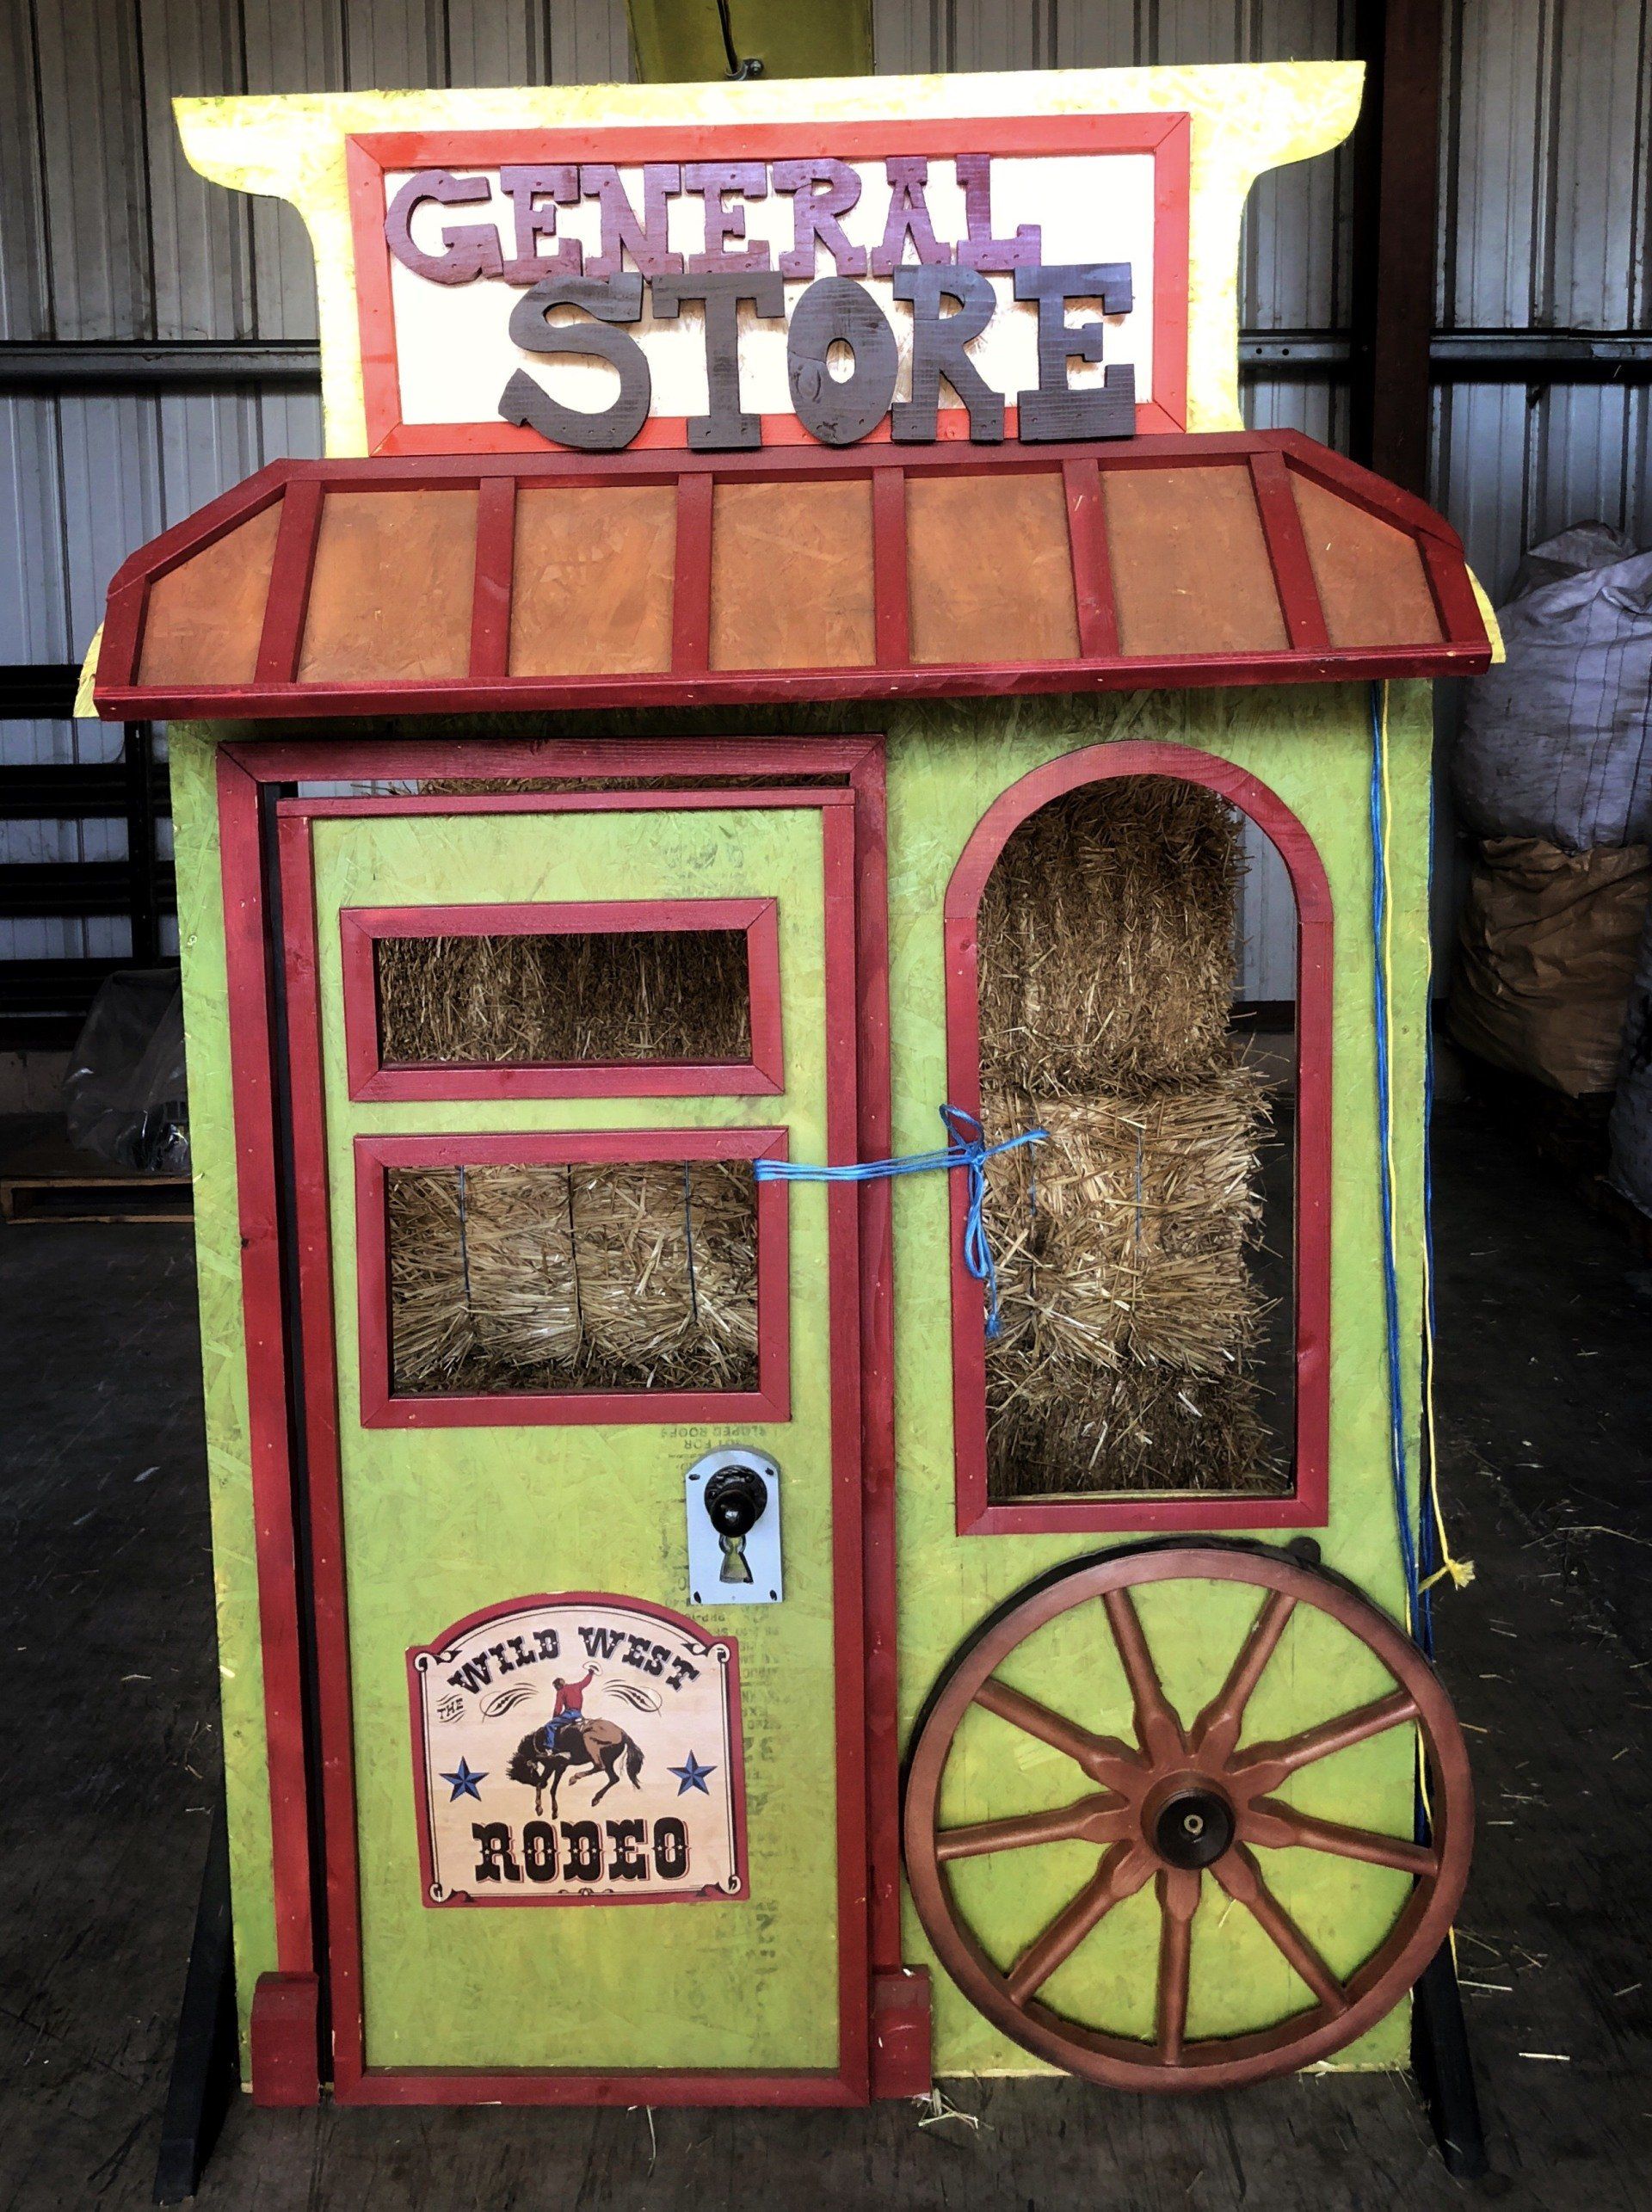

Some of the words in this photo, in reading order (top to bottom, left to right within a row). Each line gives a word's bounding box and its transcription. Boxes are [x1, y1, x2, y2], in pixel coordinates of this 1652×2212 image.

[384, 154, 1041, 287] GENERAL
[497, 262, 1136, 449] STORE
[447, 1629, 561, 1695] WILD
[577, 1626, 701, 1692] WEST
[436, 1698, 464, 1720] THE
[472, 1816, 693, 1883] RODEO
